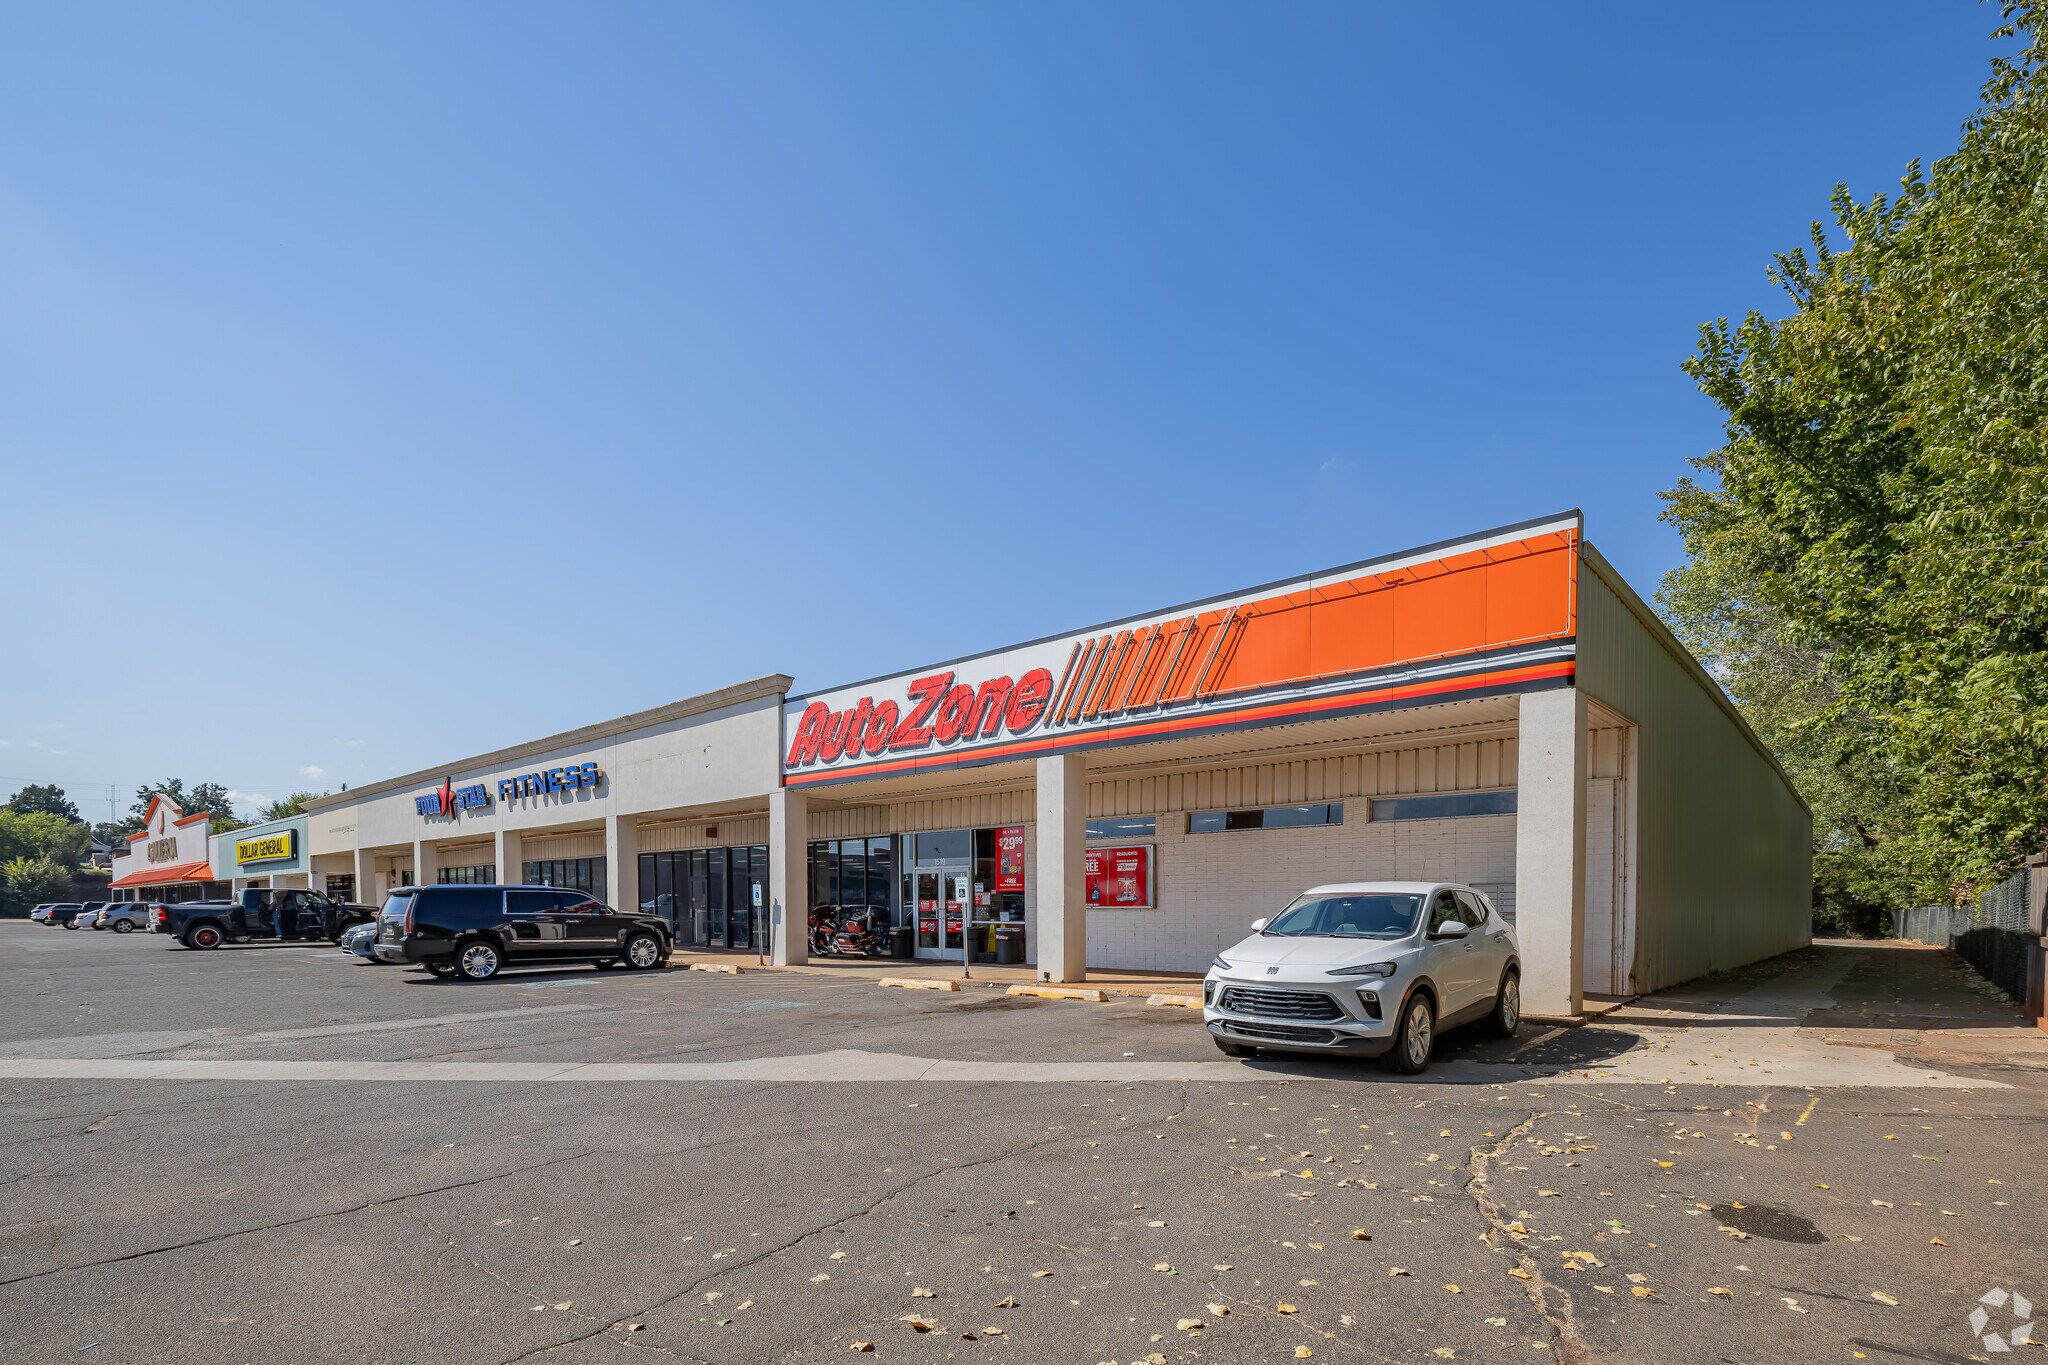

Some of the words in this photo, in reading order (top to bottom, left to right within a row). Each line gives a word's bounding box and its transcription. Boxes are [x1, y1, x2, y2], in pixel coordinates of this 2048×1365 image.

[785, 667, 1054, 769] AutoZone
[415, 793, 441, 816] FOUR
[456, 784, 488, 810] STAR
[498, 762, 599, 802] FITNESS
[240, 842, 259, 859] DOLLAR
[260, 837, 284, 856] GENERAL
